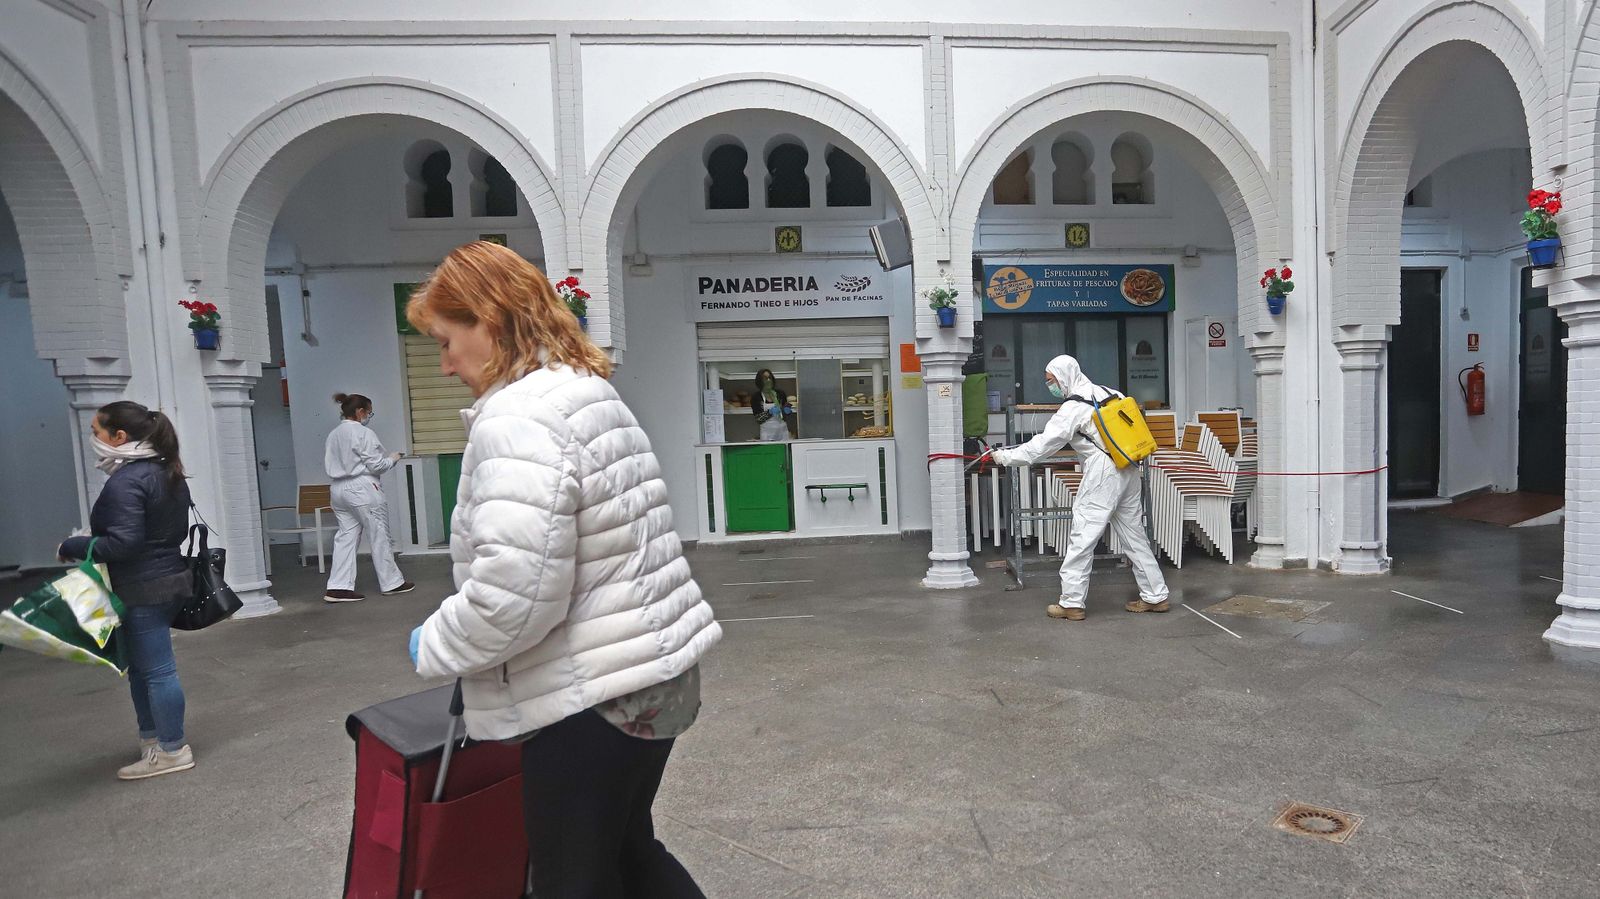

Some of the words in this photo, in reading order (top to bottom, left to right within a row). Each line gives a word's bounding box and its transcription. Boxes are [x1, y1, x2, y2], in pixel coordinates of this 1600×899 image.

[1044, 268, 1098, 278] ESPECIALIDAD
[698, 276, 819, 294] PANADERIA
[701, 301, 751, 310] FERNANDO
[753, 300, 782, 308] TINEO
[792, 299, 819, 307] HIJOS
